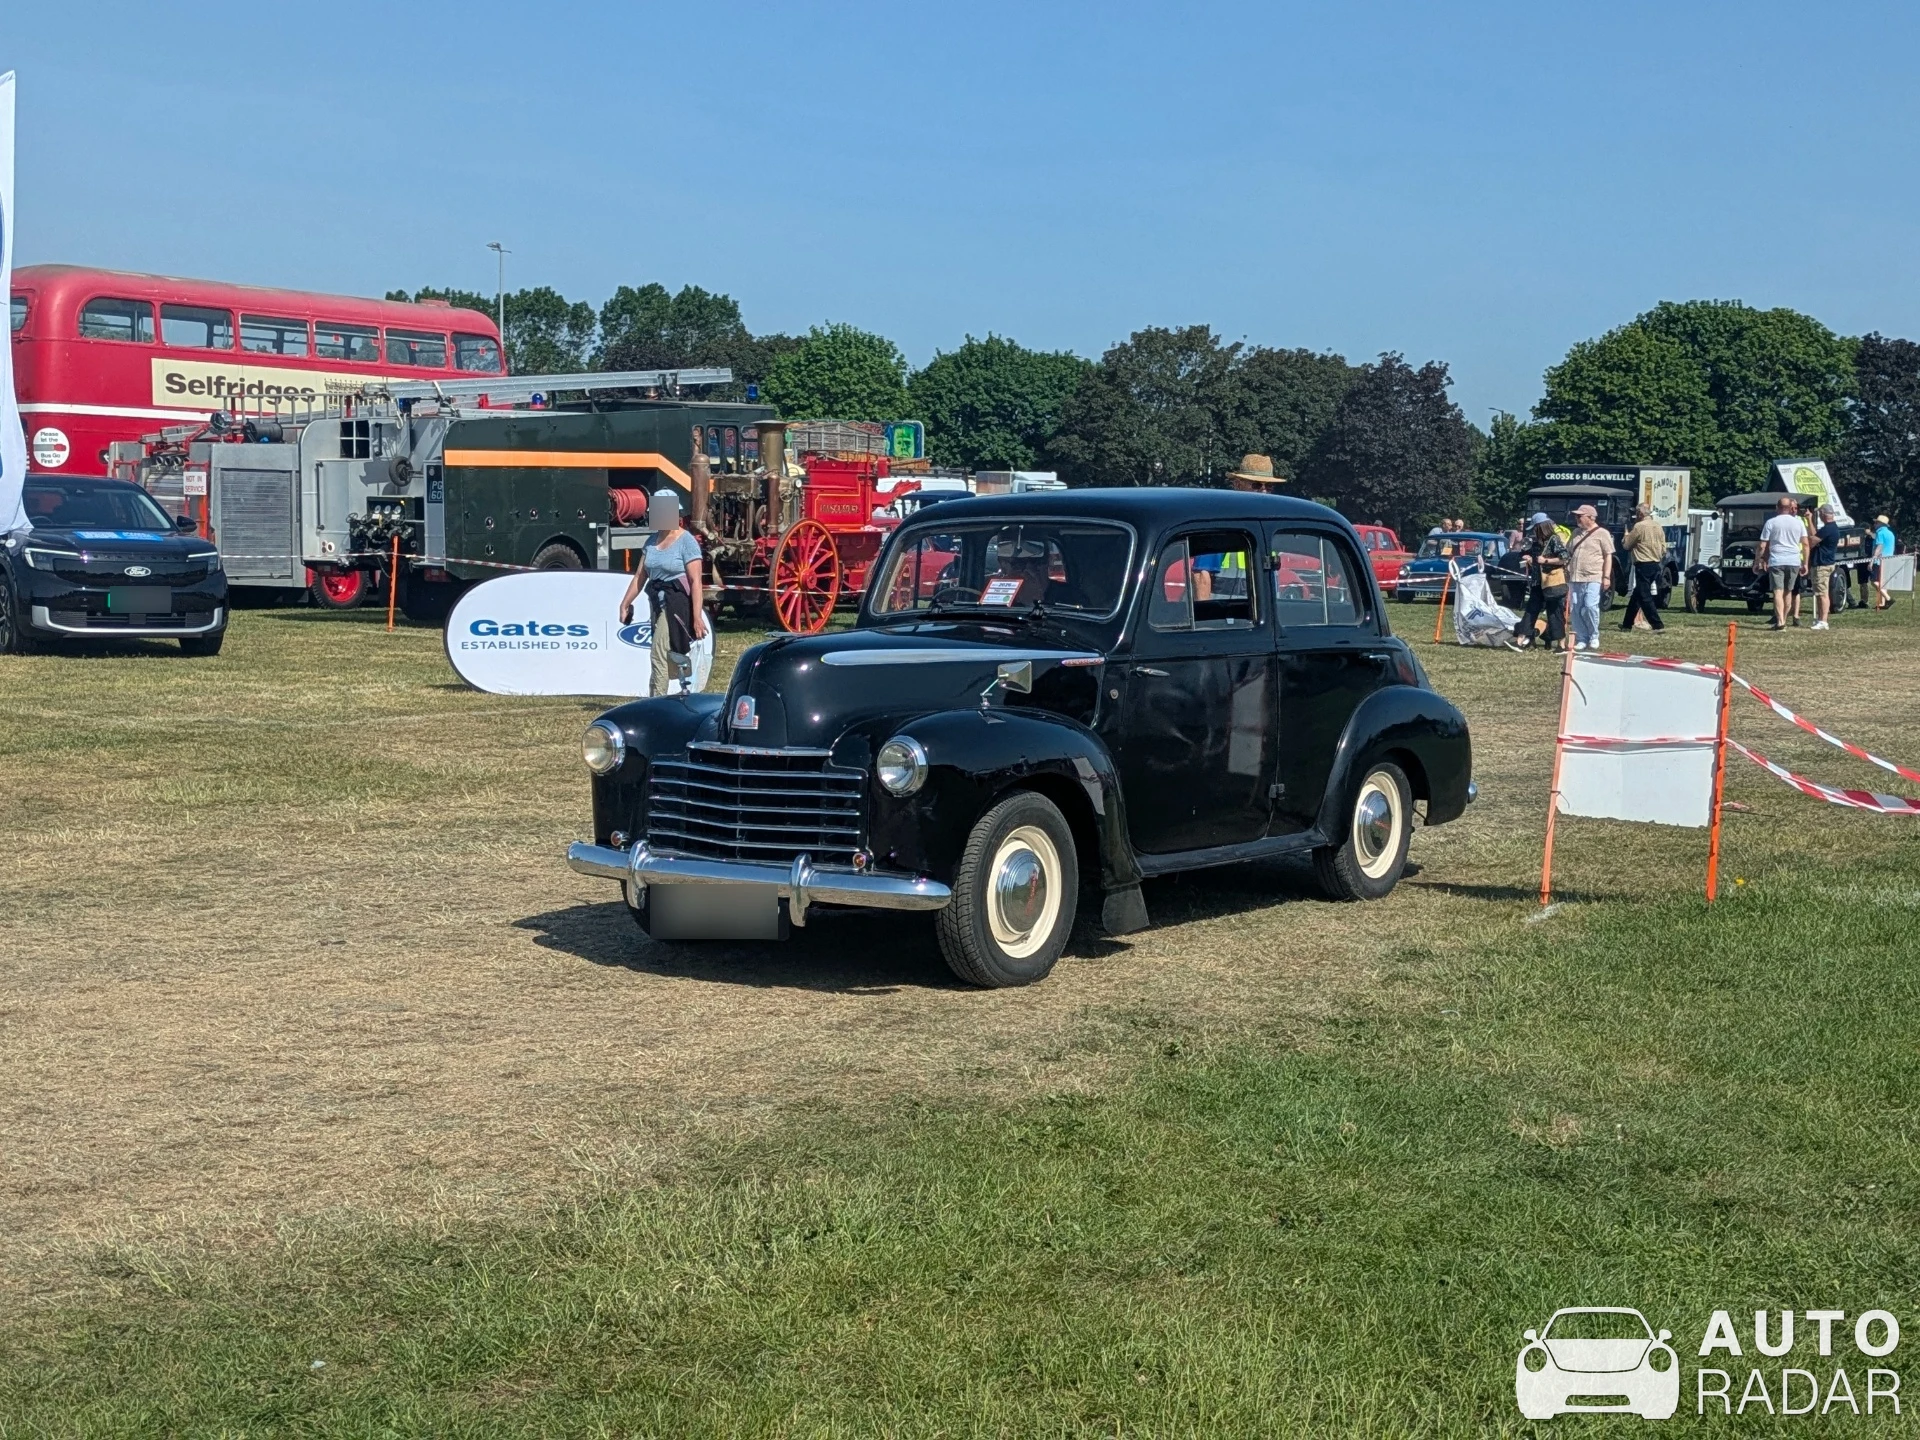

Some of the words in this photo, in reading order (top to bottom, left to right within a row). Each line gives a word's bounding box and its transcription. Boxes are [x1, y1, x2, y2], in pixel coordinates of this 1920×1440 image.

[165, 372, 316, 405] Selfridges
[1582, 473, 1625, 481] BLACKWELL
[185, 485, 205, 493] SERVICE
[1653, 478, 1677, 492] FAMOUS
[1653, 504, 1676, 518] PRODUCTS
[469, 619, 590, 637] Gates
[461, 641, 560, 650] ESTABLISHED
[565, 641, 598, 650] 1920
